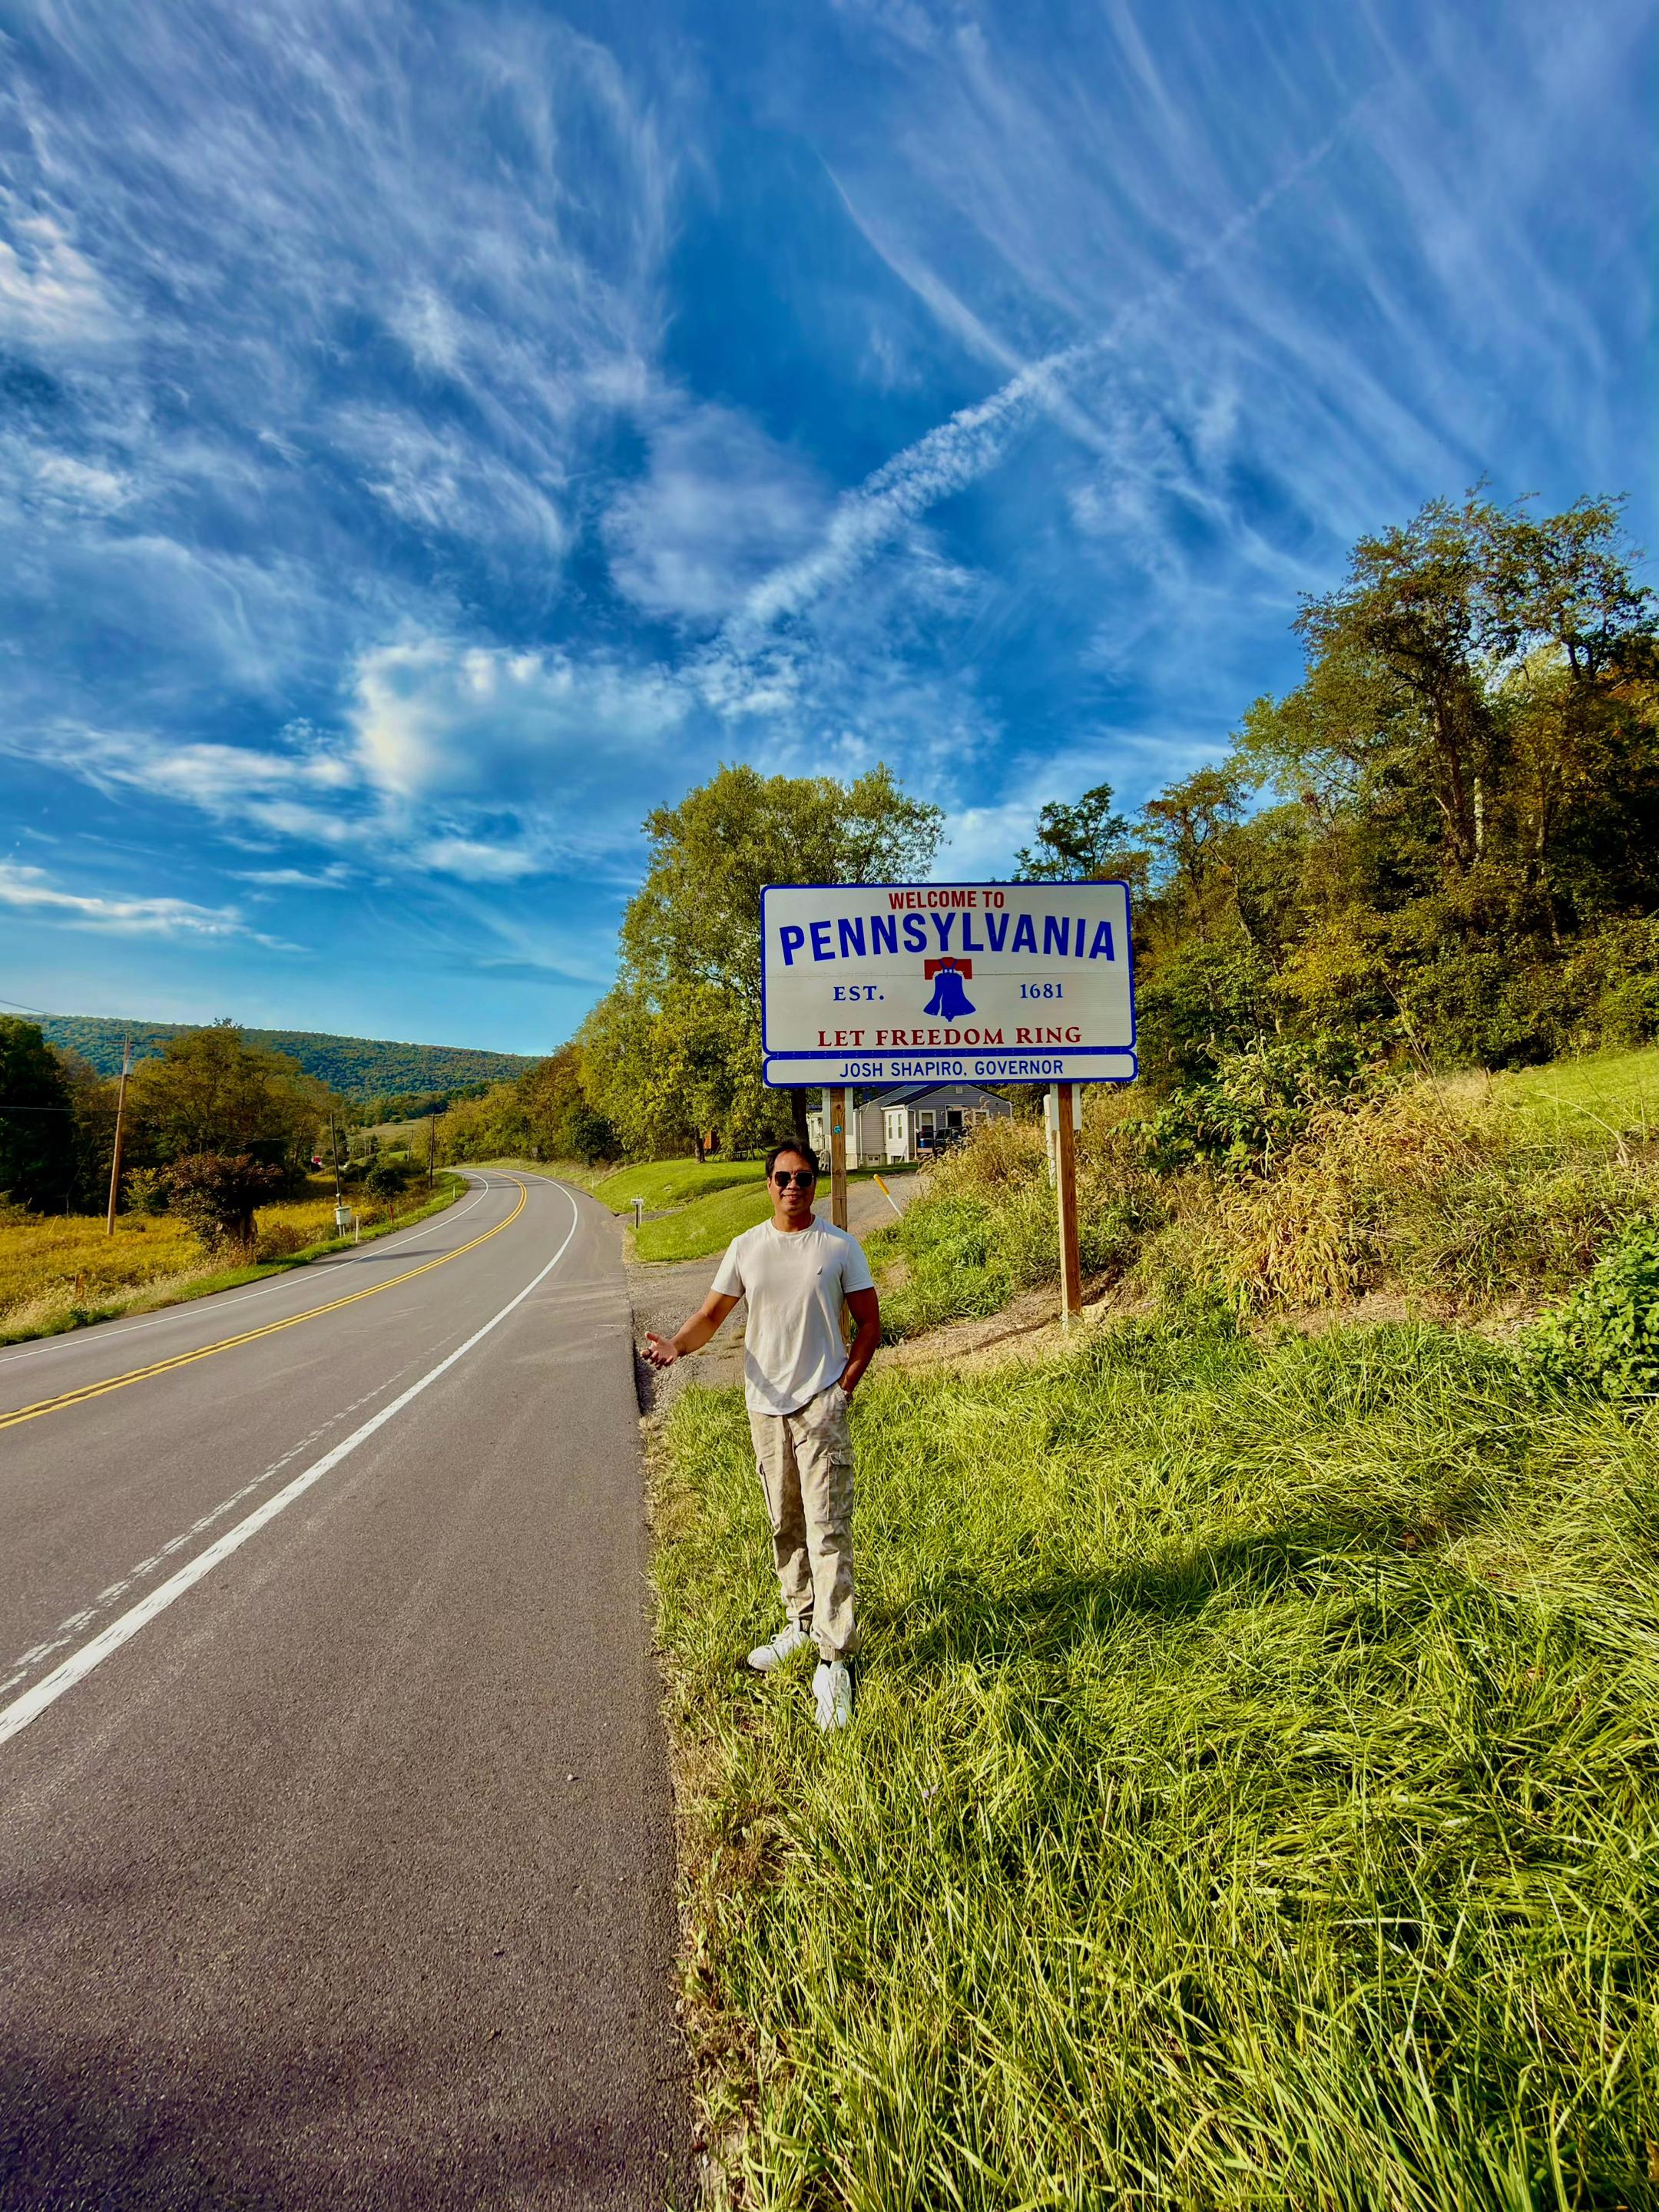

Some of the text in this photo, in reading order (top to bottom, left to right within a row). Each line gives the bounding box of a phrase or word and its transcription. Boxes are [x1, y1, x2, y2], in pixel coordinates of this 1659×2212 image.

[889, 890, 1005, 909] WELCOME TO
[779, 912, 1116, 966] PENNSYLVANIA
[833, 983, 1064, 1001] EST. 1681
[817, 1026, 1081, 1047] LET FREEDOM RING
[839, 1060, 1064, 1078] JOSH SHAPIRO, GOVERNOR
